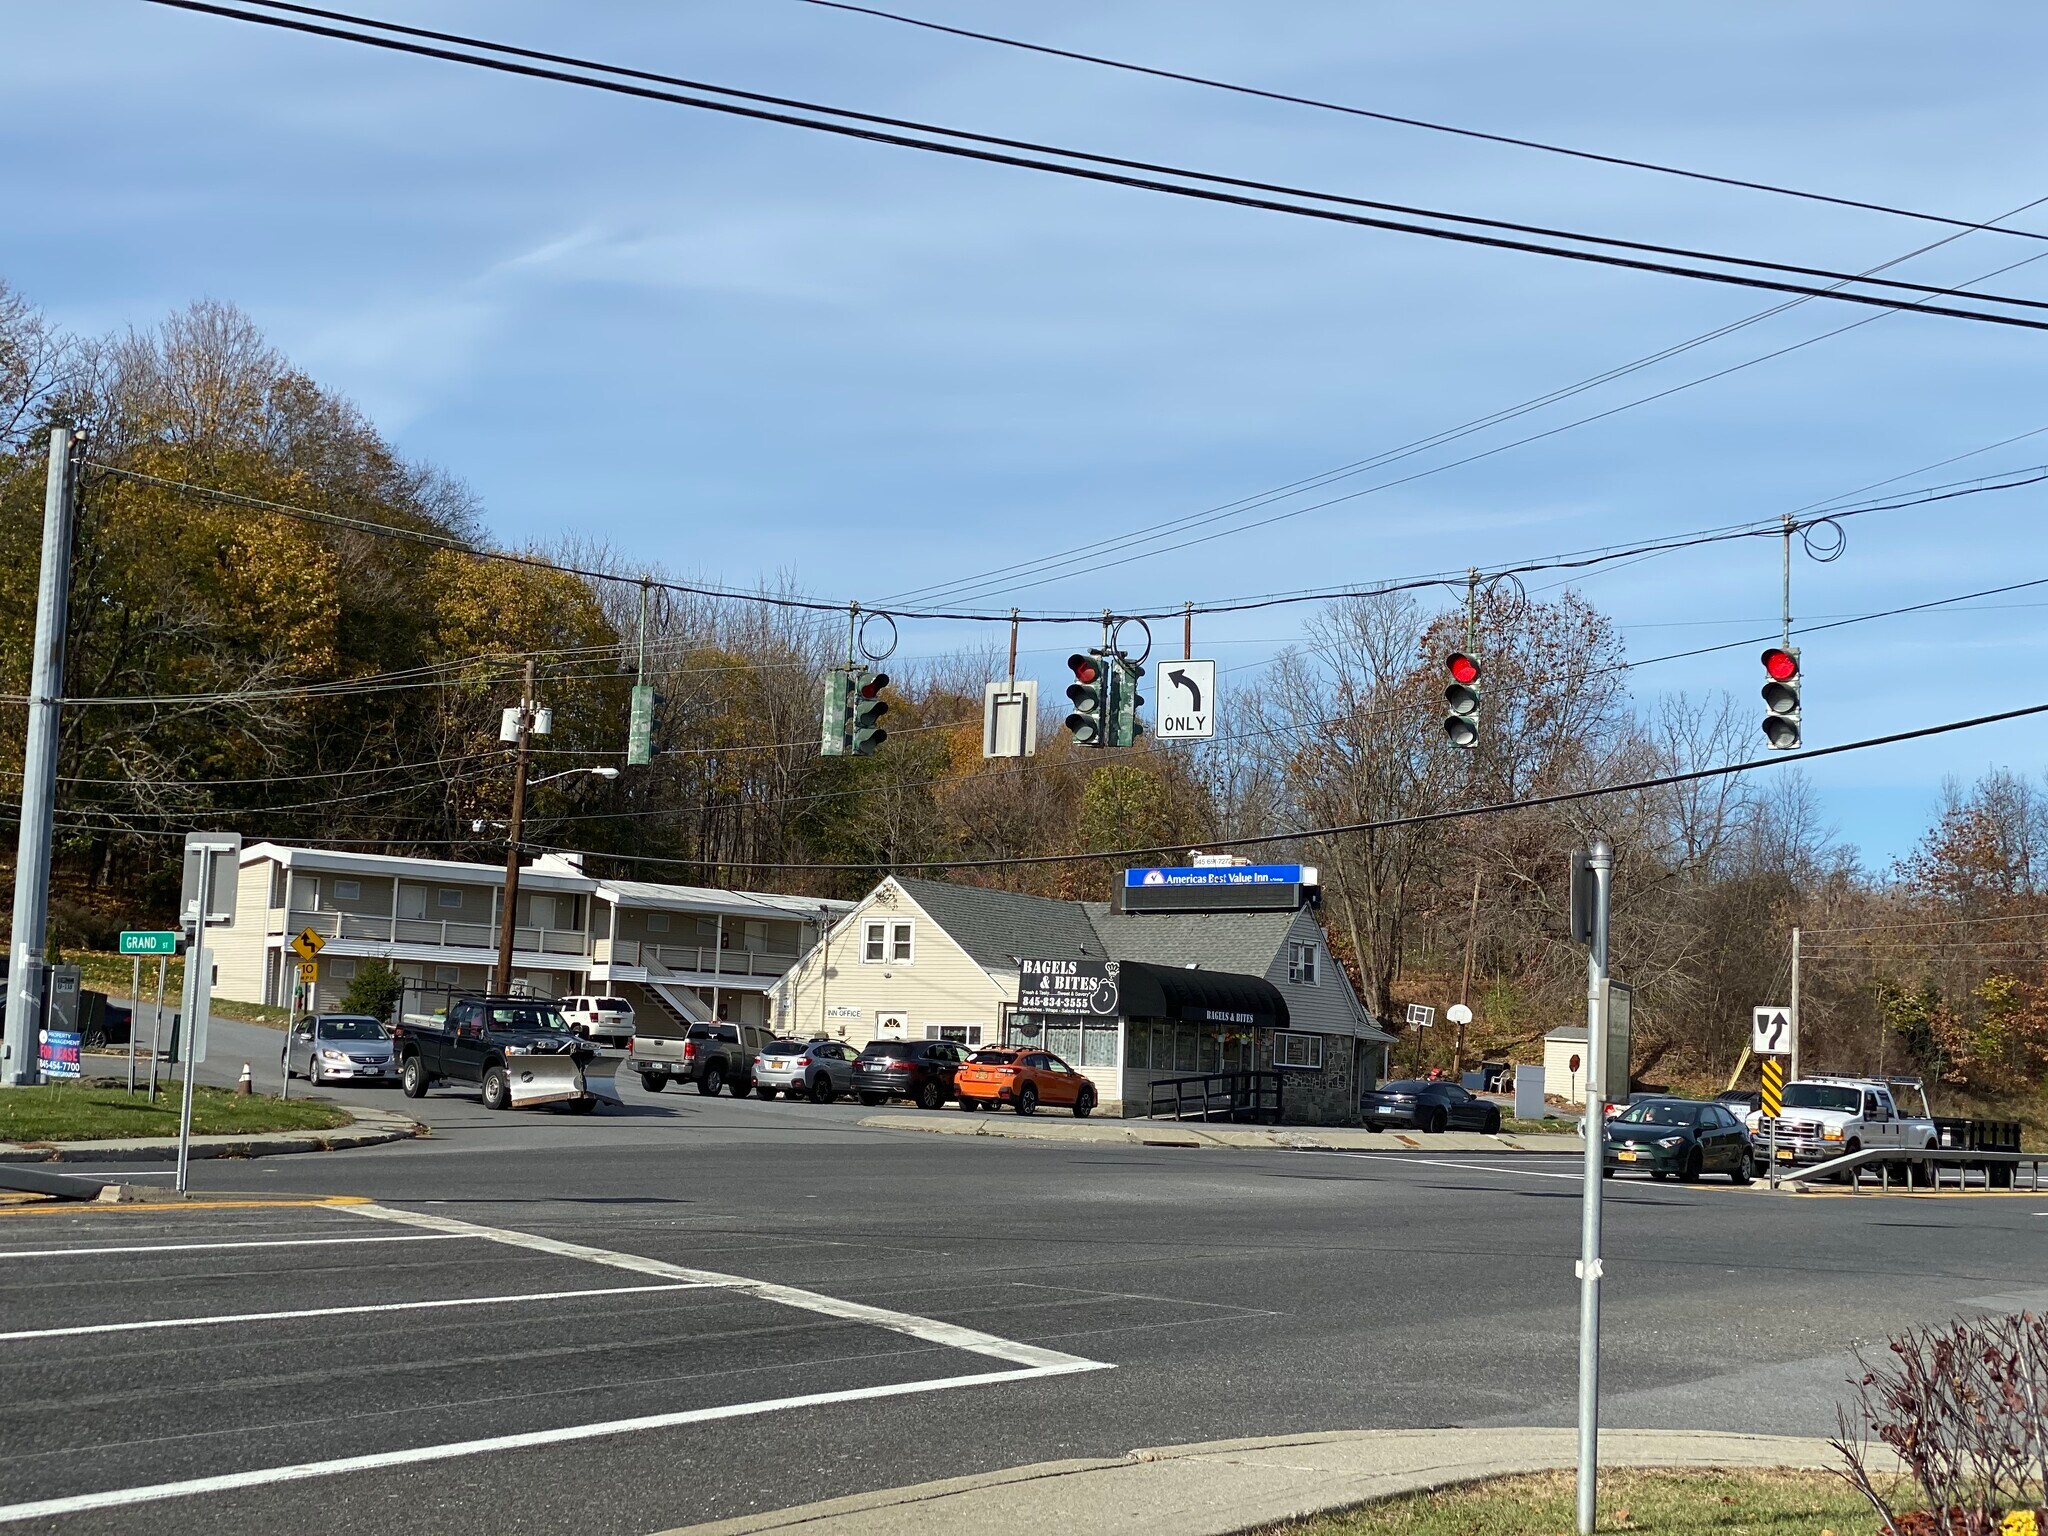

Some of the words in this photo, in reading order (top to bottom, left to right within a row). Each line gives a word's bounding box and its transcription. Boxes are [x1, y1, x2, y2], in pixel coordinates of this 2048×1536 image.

[1165, 716, 1206, 731] ONLY
[1166, 873, 1206, 884] Americas
[1208, 874, 1226, 883] Best
[1228, 872, 1252, 882] Value
[1254, 872, 1268, 882] Inn
[126, 936, 156, 948] GRAND
[302, 964, 314, 974] 10
[1022, 960, 1077, 974] BAGELS
[1040, 976, 1050, 989] &
[1054, 976, 1098, 990] BITES
[1022, 996, 1088, 1008] 845-834-3555
[1206, 1010, 1230, 1020] BAGELS
[1230, 1012, 1234, 1022] &
[1236, 1013, 1254, 1023] BITES
[40, 1044, 52, 1060] FOR
[54, 1046, 78, 1062] LEASE
[40, 1059, 80, 1071] 845-454-7700
